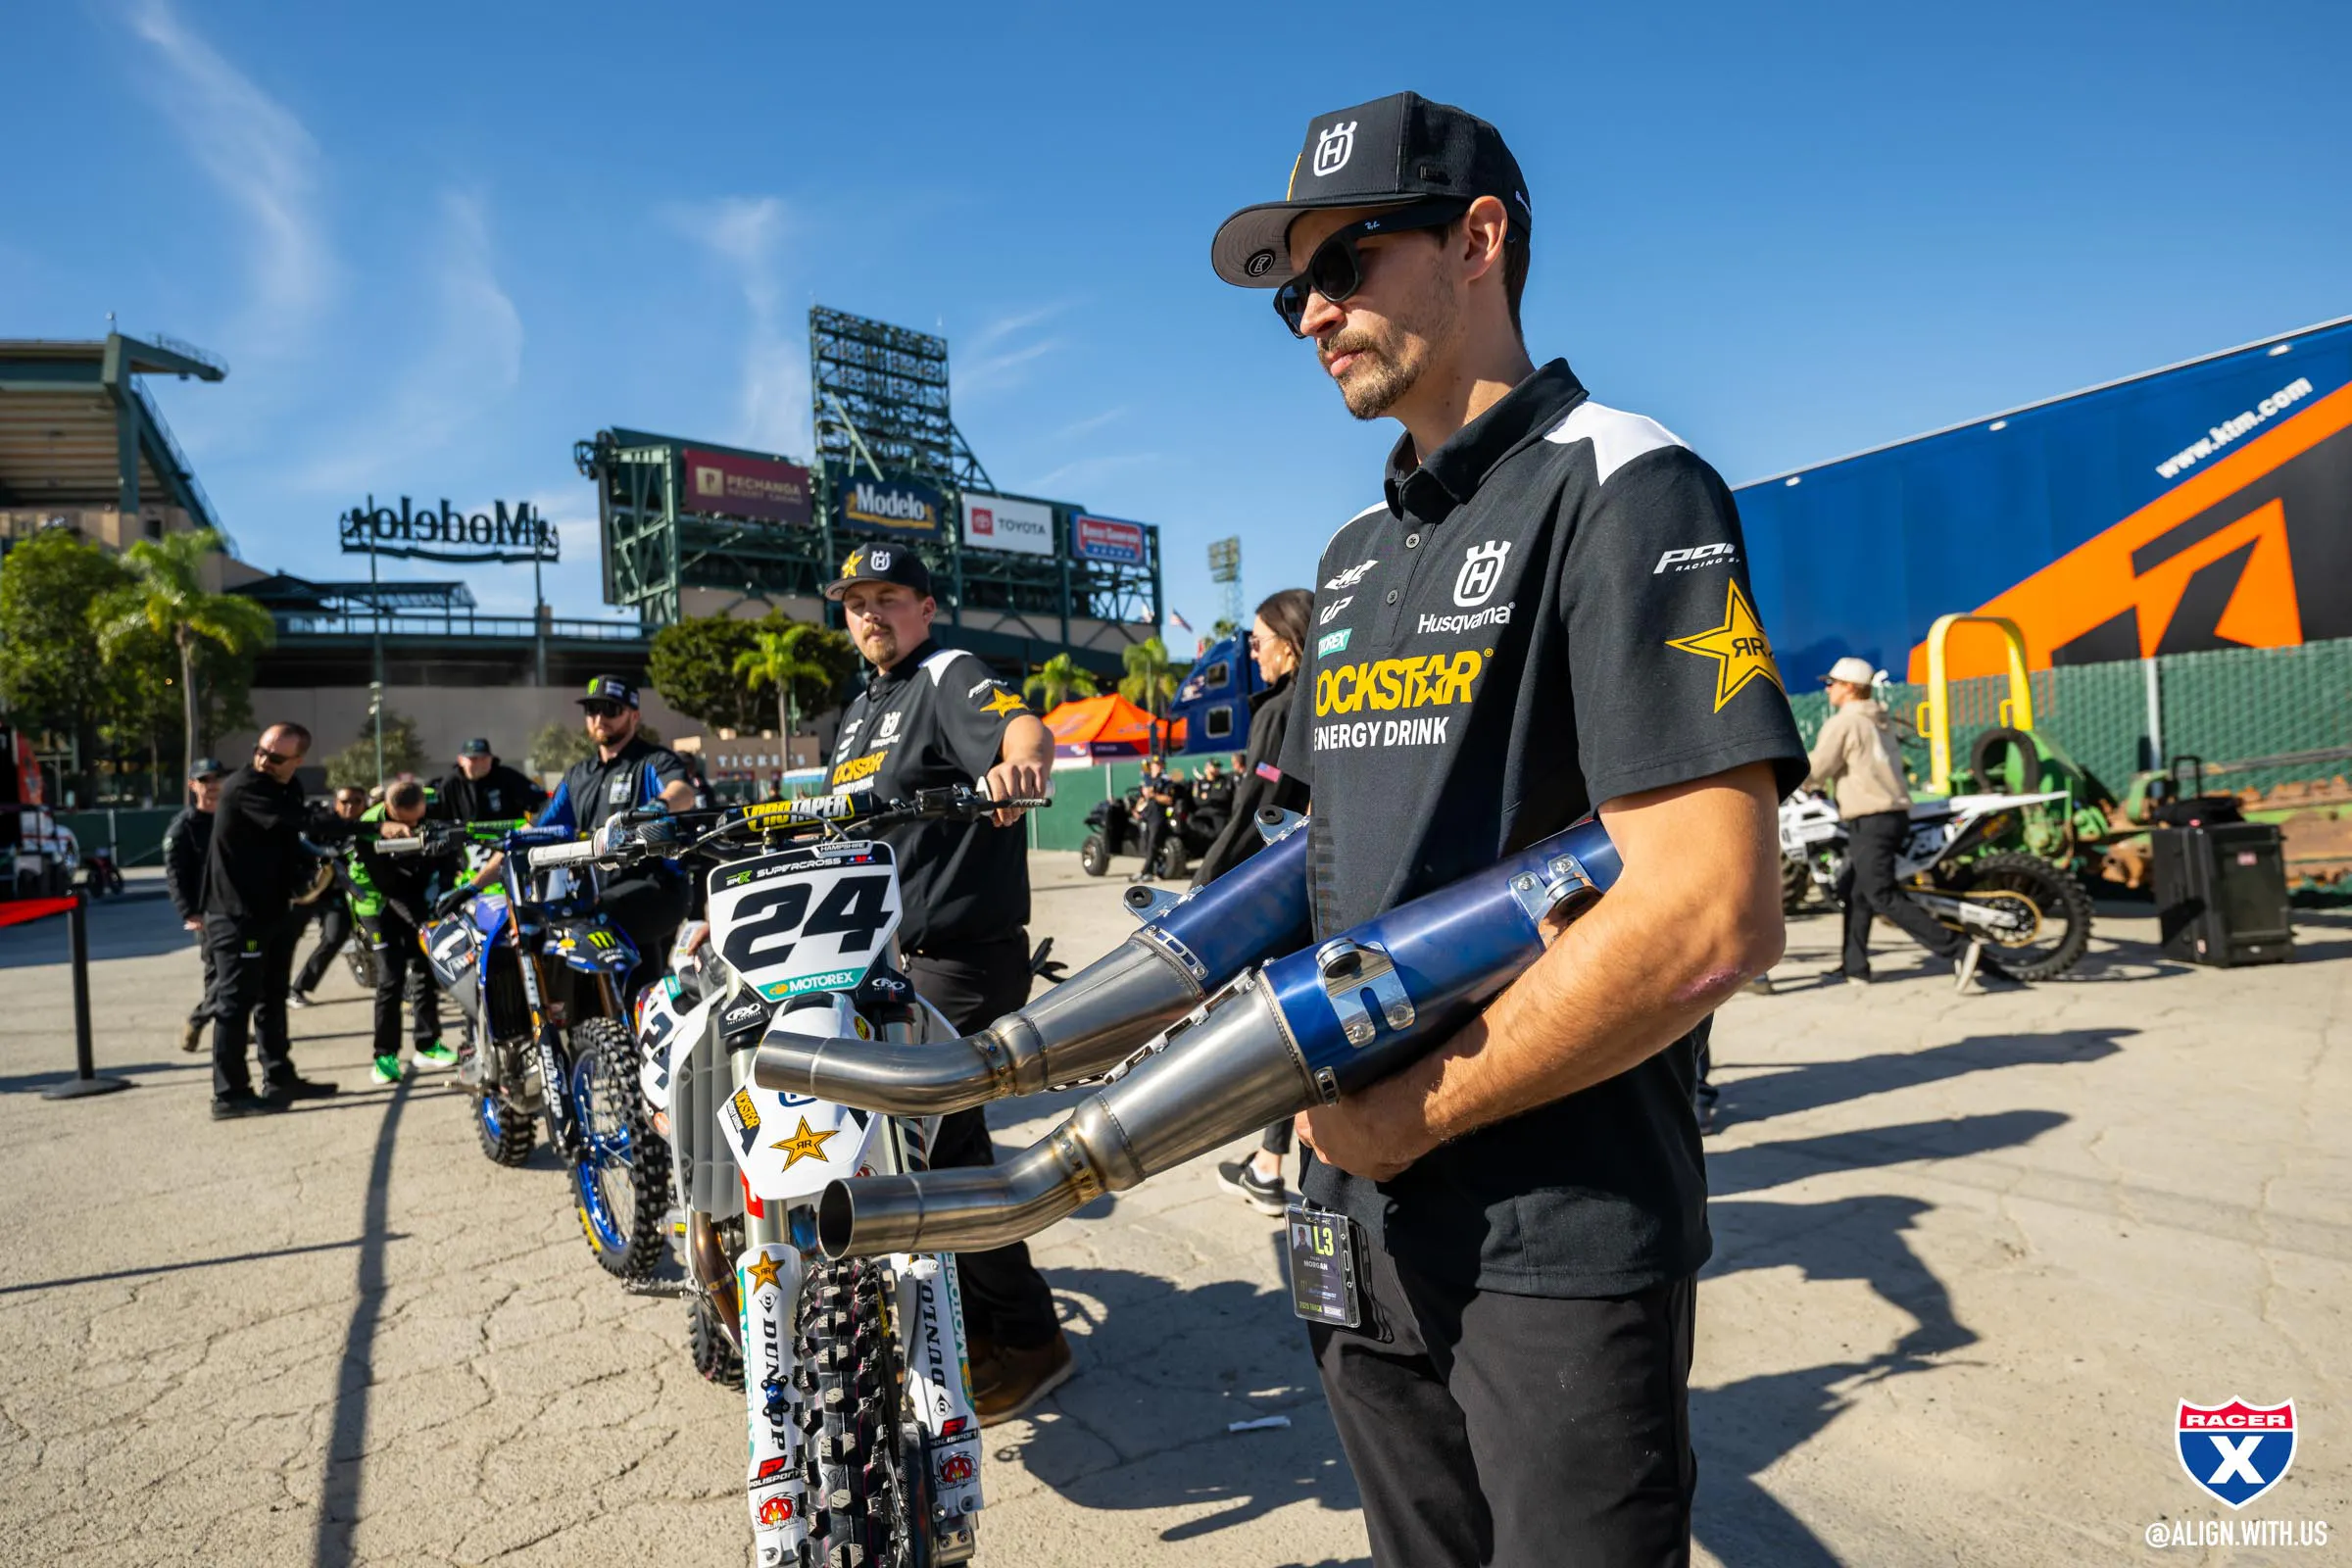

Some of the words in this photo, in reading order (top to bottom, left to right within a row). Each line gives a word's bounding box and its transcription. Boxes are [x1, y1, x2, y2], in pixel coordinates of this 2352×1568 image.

[2155, 376, 2314, 478] www.ktm.com
[727, 475, 801, 495] PECHANGA
[856, 483, 925, 520] Modelo
[998, 517, 1047, 535] TOYOTA
[1675, 558, 1722, 572] RACING
[1384, 716, 1449, 747] DRINK
[757, 857, 842, 878] SUPERCROSS
[722, 875, 894, 973] 24
[789, 972, 855, 993] MOTOREX
[1313, 1225, 1334, 1256] L3
[944, 1252, 968, 1359] MOTORE
[920, 1279, 947, 1389] DUNLO
[762, 1318, 785, 1451] DUNOP
